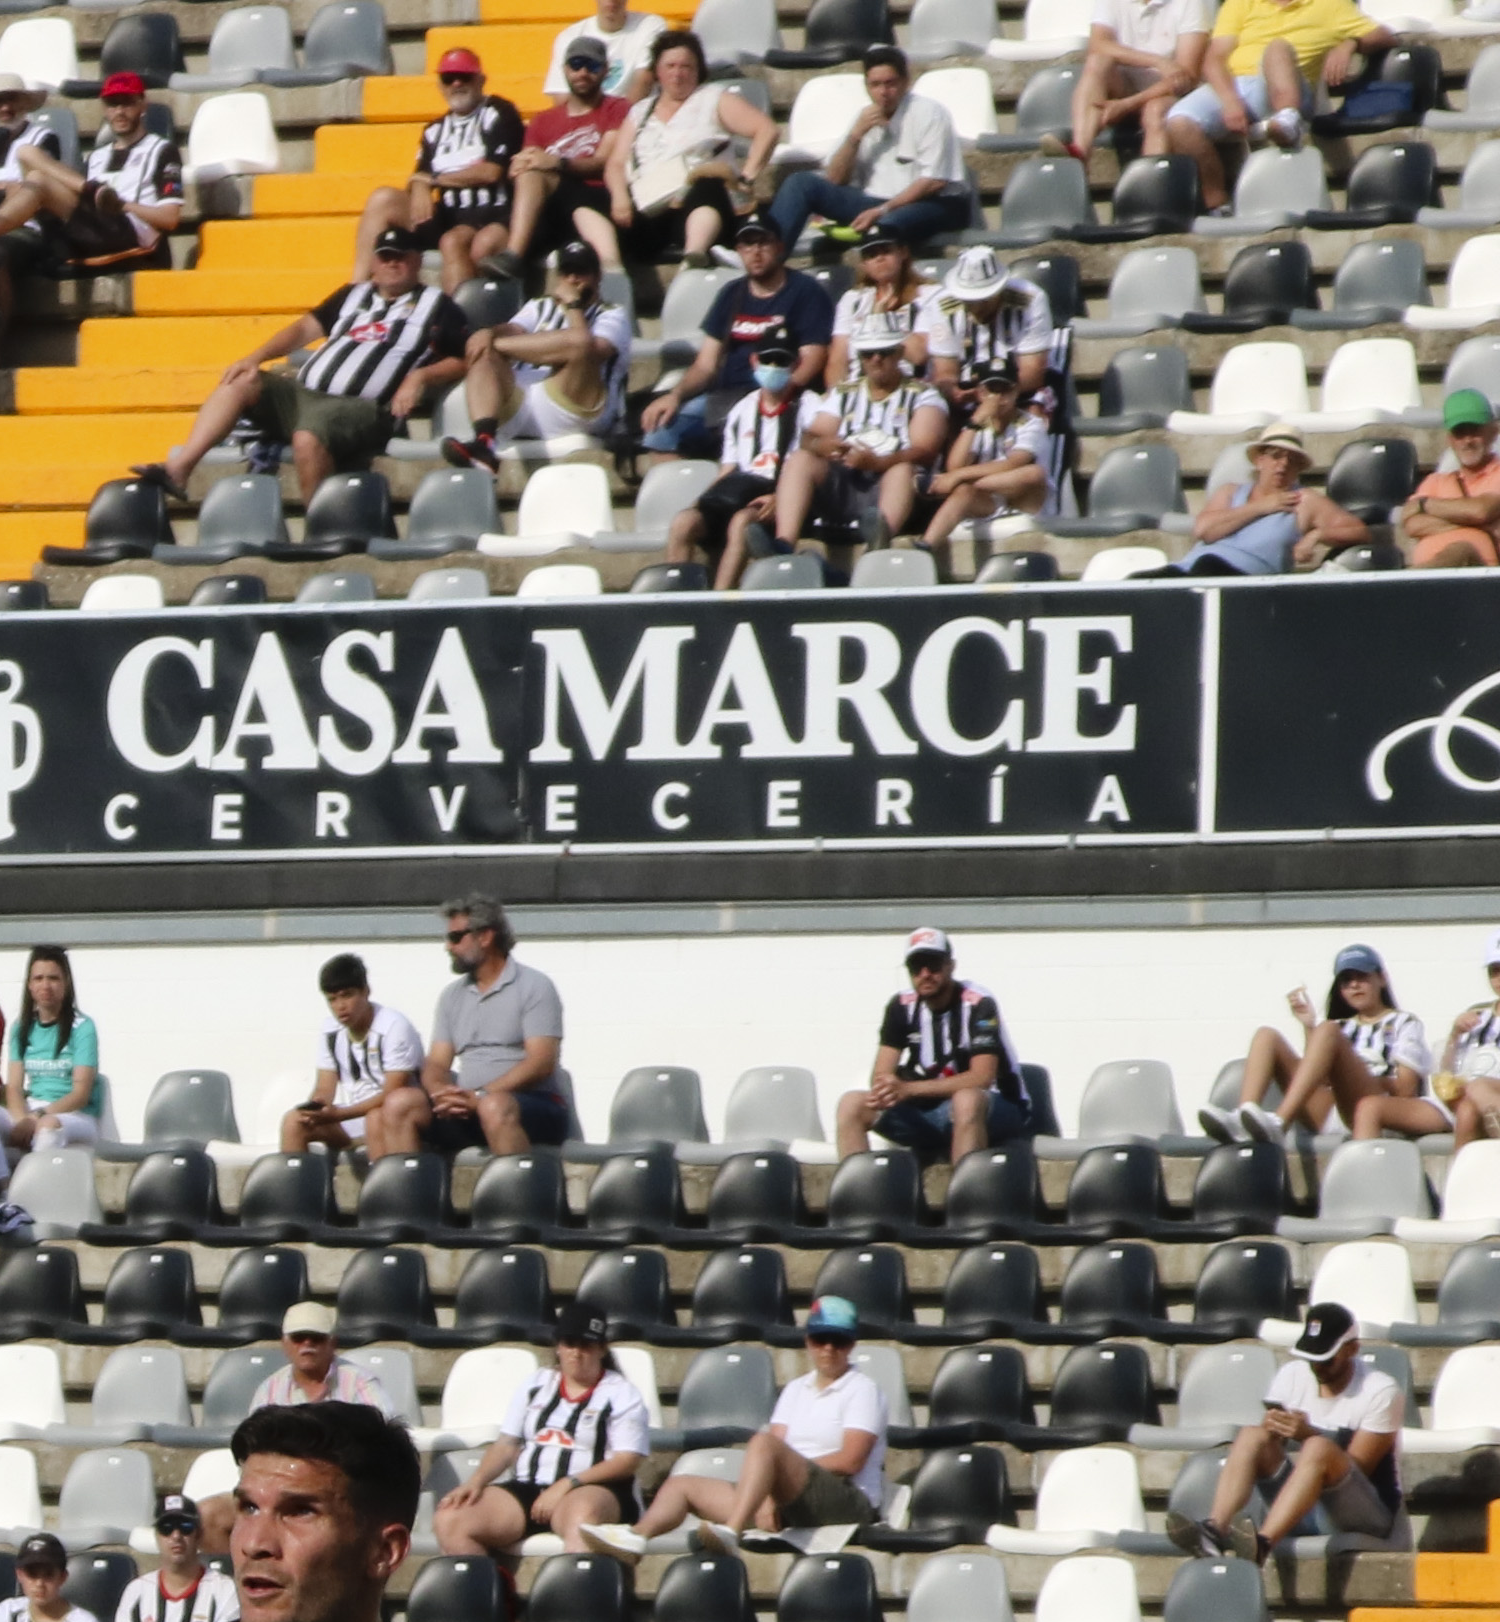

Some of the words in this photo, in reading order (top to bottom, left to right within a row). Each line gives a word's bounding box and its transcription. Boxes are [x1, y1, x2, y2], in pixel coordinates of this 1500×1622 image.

[106, 626, 503, 776] CASA
[529, 613, 1136, 764] MARCE
[104, 765, 1132, 844] CERVECERÍA
